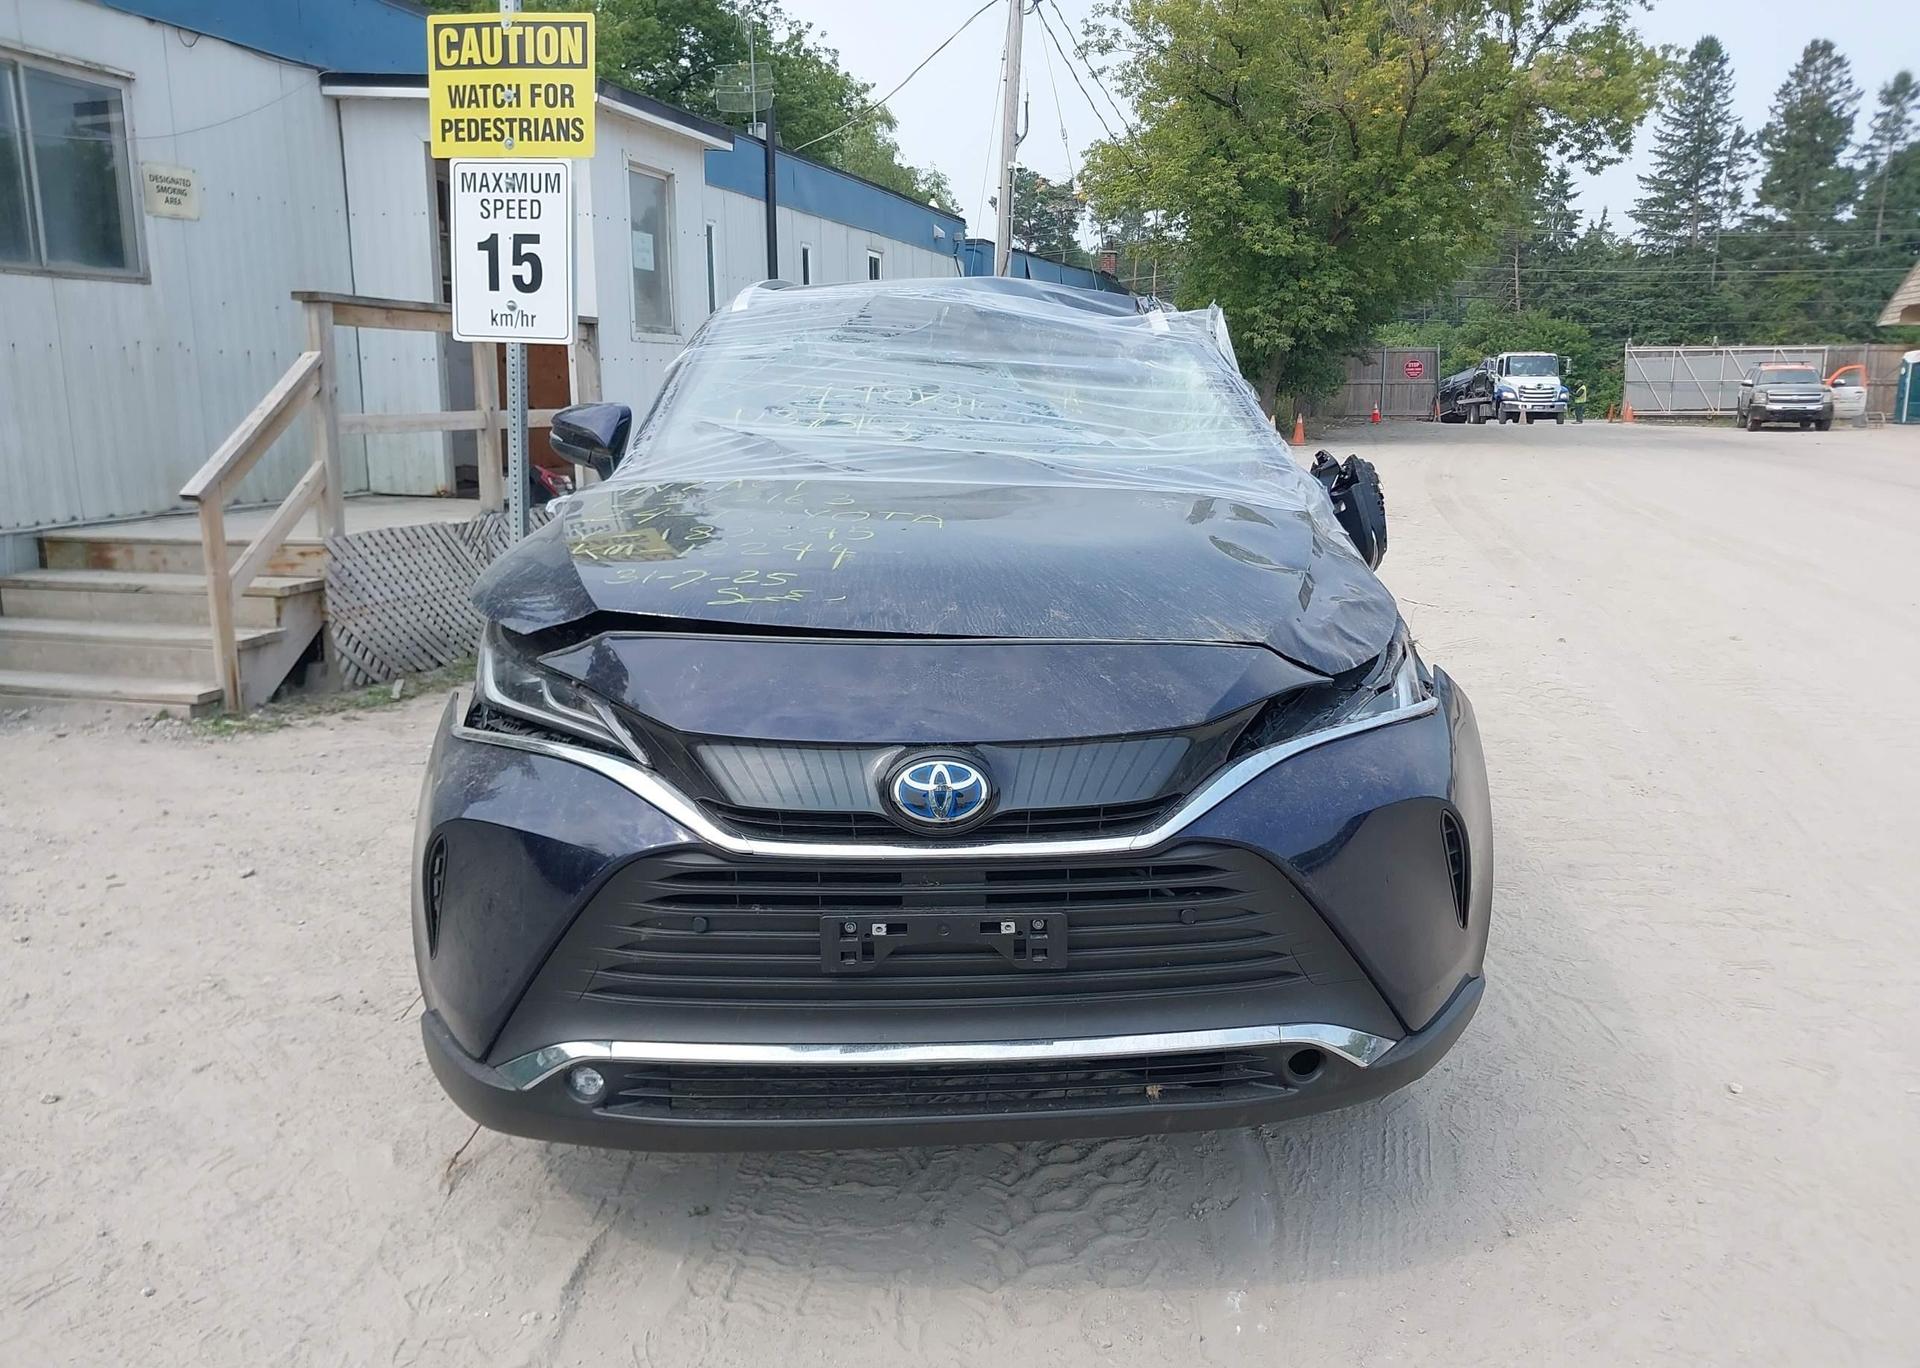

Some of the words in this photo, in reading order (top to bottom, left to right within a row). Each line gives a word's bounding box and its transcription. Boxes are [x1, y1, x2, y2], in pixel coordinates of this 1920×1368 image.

[438, 25, 584, 67] CAUTION
[447, 84, 521, 109] WATCH
[530, 84, 574, 108] FOR
[441, 117, 585, 144] PEDESTRIANS
[460, 172, 561, 194] MAXIMUM
[480, 198, 542, 220] SPEED
[476, 233, 543, 294] 15
[490, 309, 537, 329] km/hr
